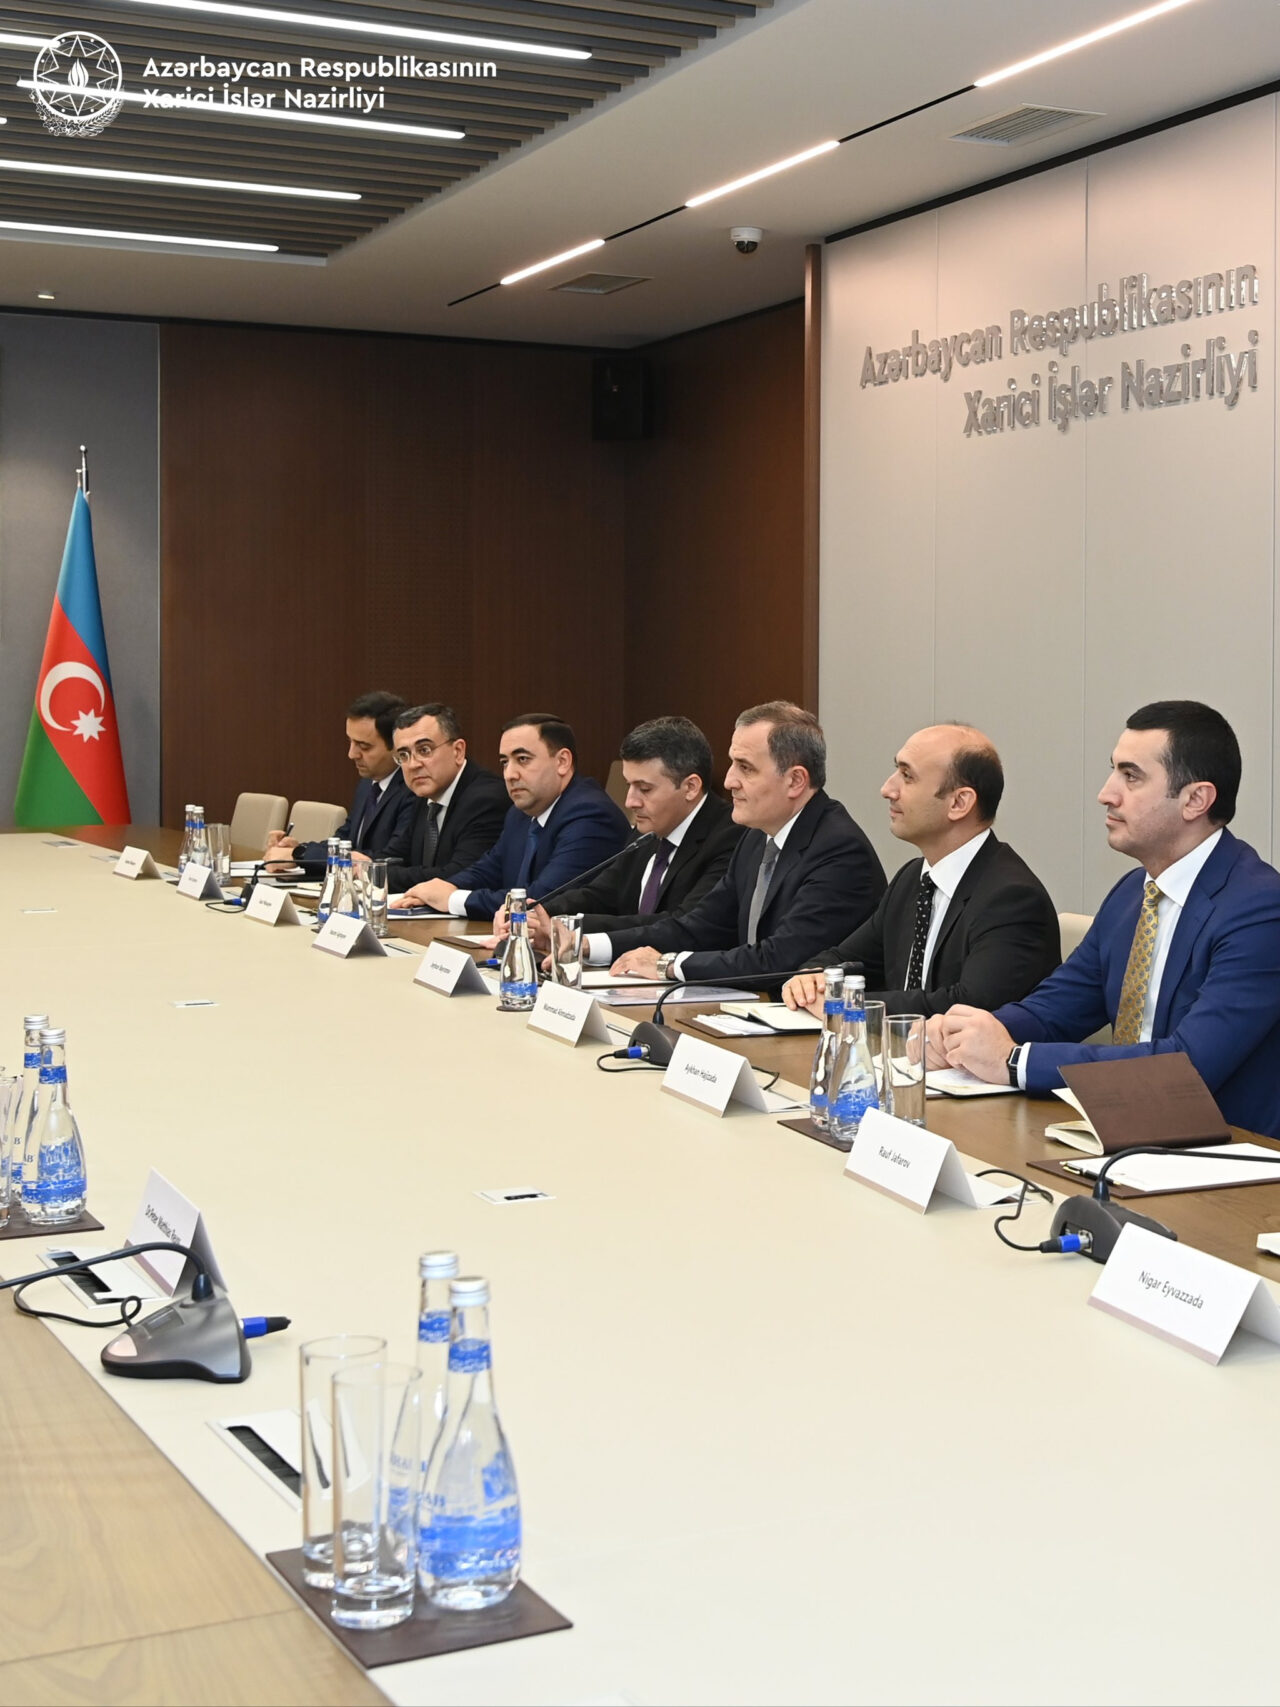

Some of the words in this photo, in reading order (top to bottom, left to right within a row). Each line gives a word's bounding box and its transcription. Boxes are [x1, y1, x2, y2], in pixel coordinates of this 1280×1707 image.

[860, 324, 1003, 389] Azərbaycan
[1009, 264, 1260, 356] Respublikasının
[963, 373, 1041, 437] Xarici
[1048, 360, 1114, 432] İşlər
[1121, 330, 1260, 411] Nazirliyi
[1138, 1270, 1162, 1290] Nigar
[1161, 1280, 1204, 1309] Eyvazzada
